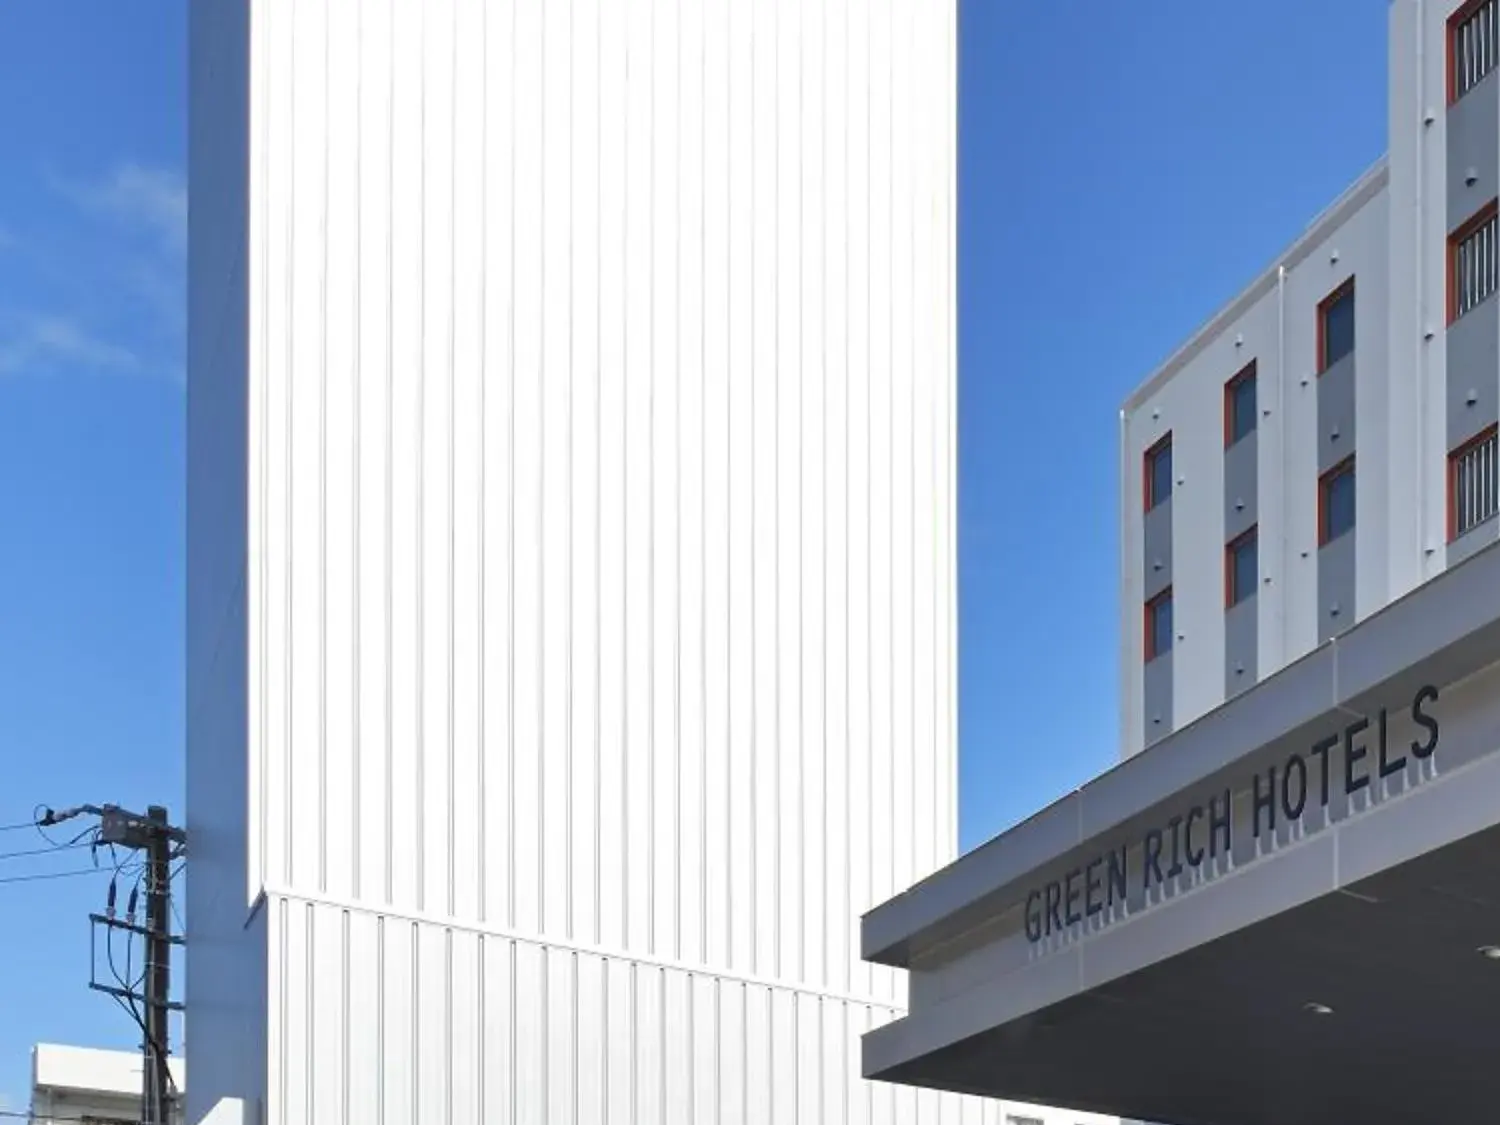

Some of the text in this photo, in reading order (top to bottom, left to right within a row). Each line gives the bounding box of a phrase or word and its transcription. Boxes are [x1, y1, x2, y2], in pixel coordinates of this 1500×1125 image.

[1024, 684, 1439, 943] GREEN RICH HOTELS
